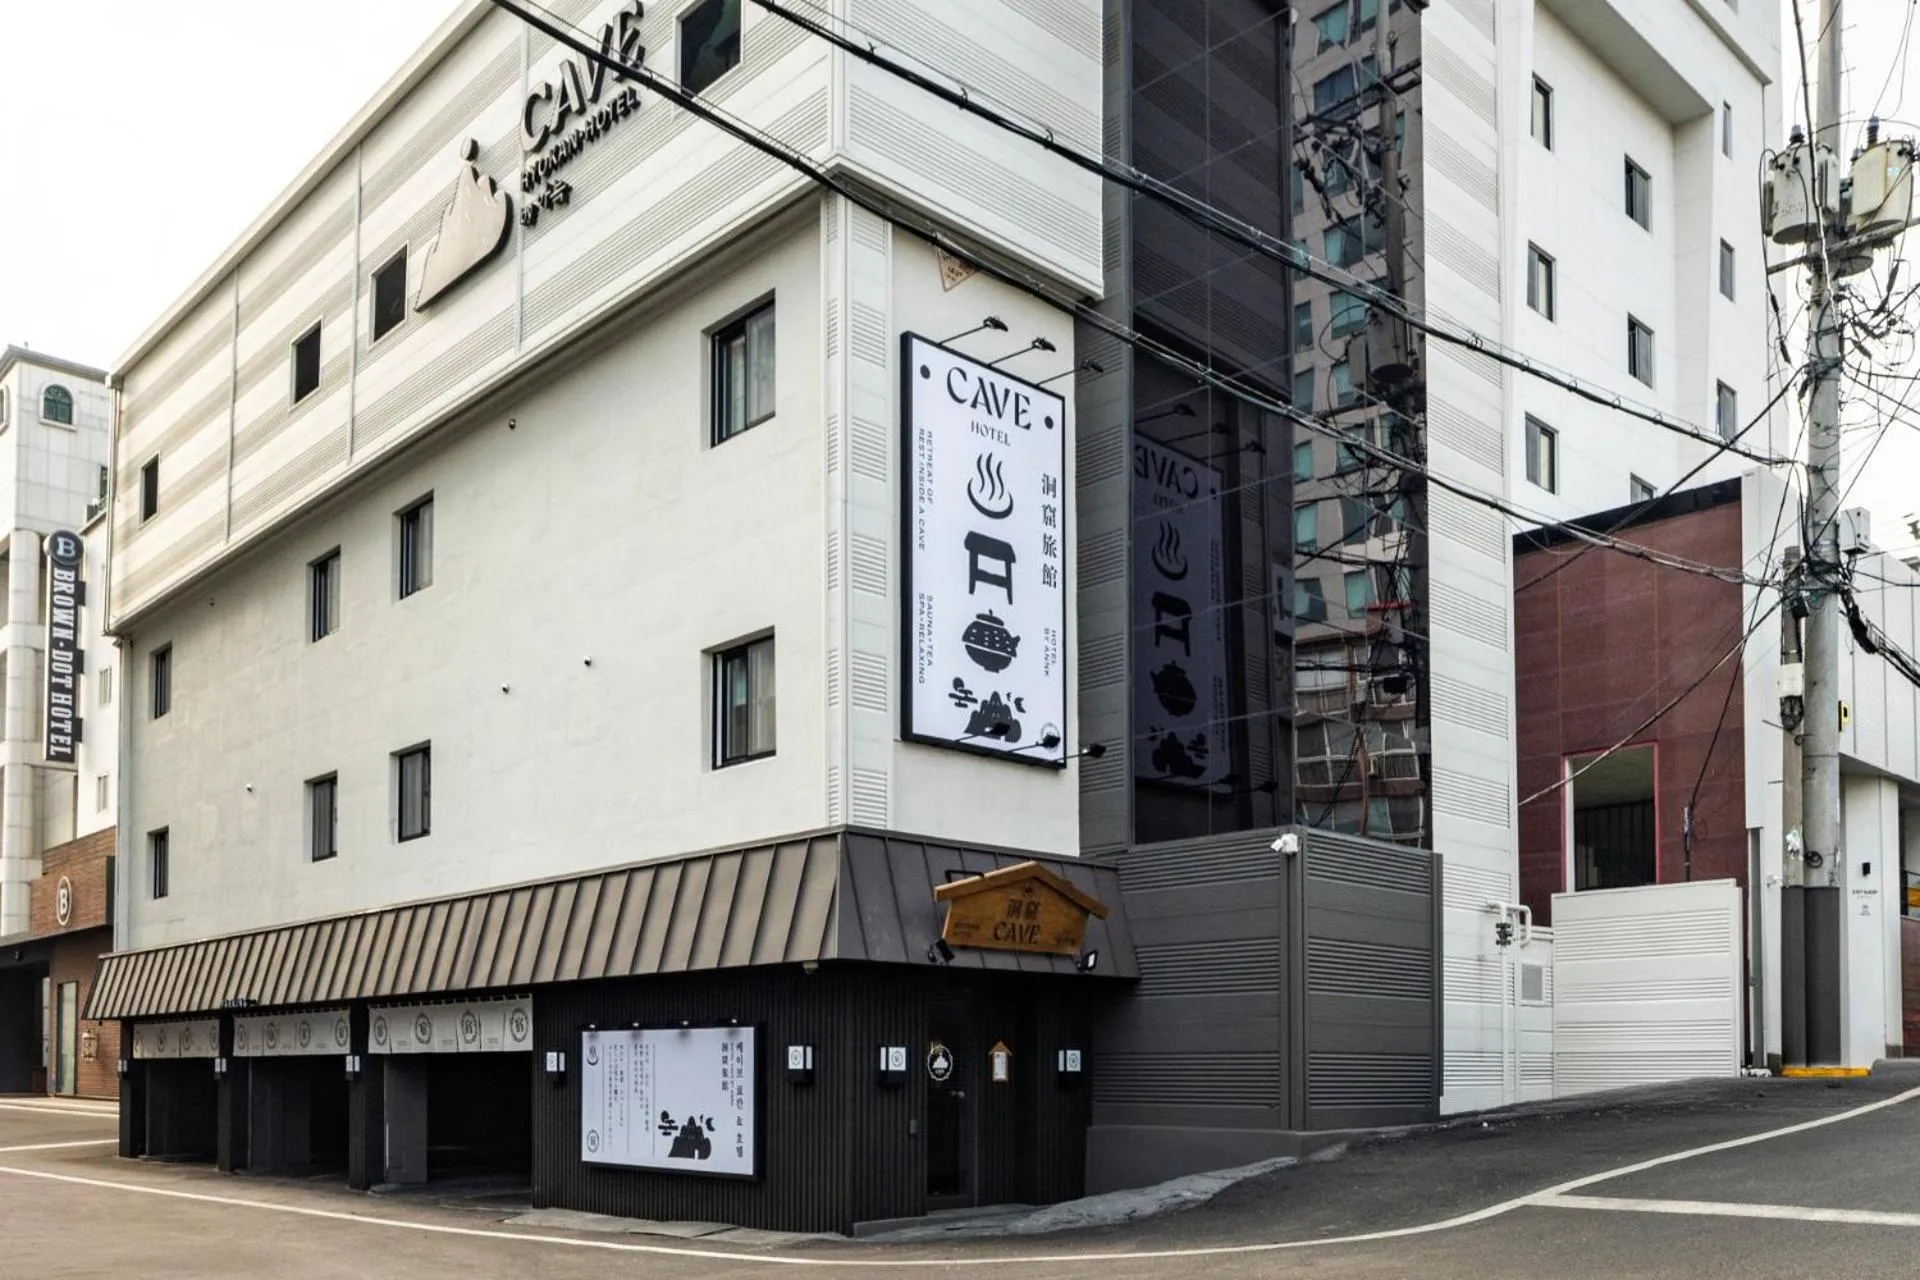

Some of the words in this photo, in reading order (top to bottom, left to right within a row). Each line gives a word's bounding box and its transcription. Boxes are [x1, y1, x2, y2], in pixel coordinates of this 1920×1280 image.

[520, 0, 647, 154] CAVE
[946, 366, 1032, 431] CAVE
[970, 419, 1011, 447] HOTEL
[56, 536, 76, 557] B
[49, 691, 73, 756] HOTEL
[59, 888, 69, 915] B
[992, 920, 1042, 945] CAVE
